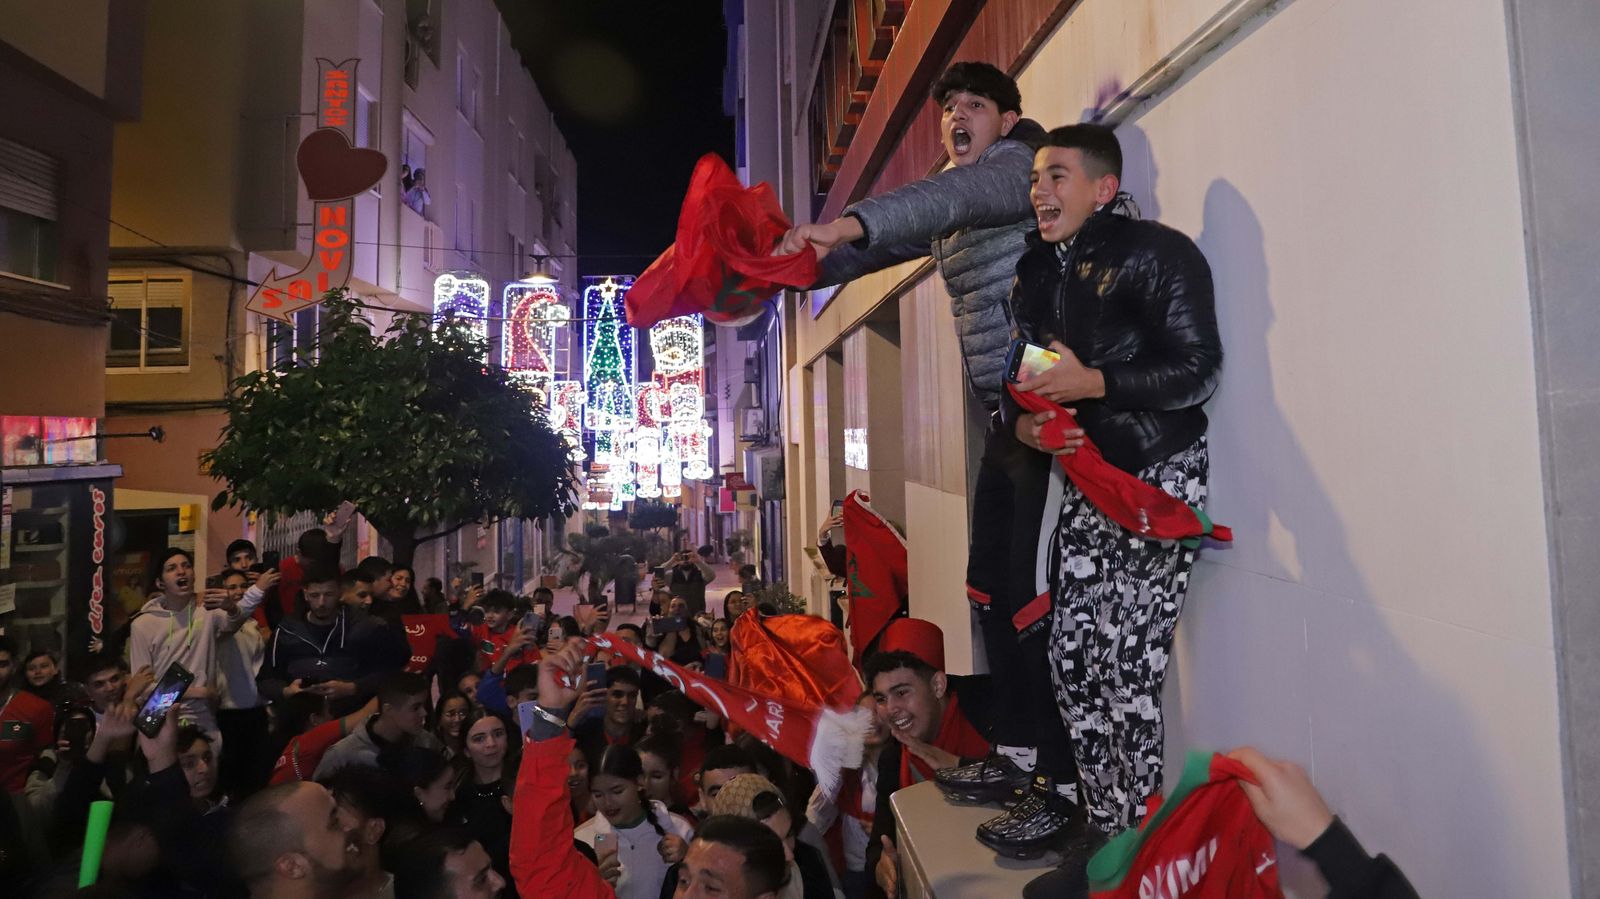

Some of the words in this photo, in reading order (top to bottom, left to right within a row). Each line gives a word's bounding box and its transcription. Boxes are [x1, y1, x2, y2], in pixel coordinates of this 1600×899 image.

[260, 206, 350, 309] NOVIAS
[92, 488, 106, 565] euros
[88, 565, 104, 634] diez
